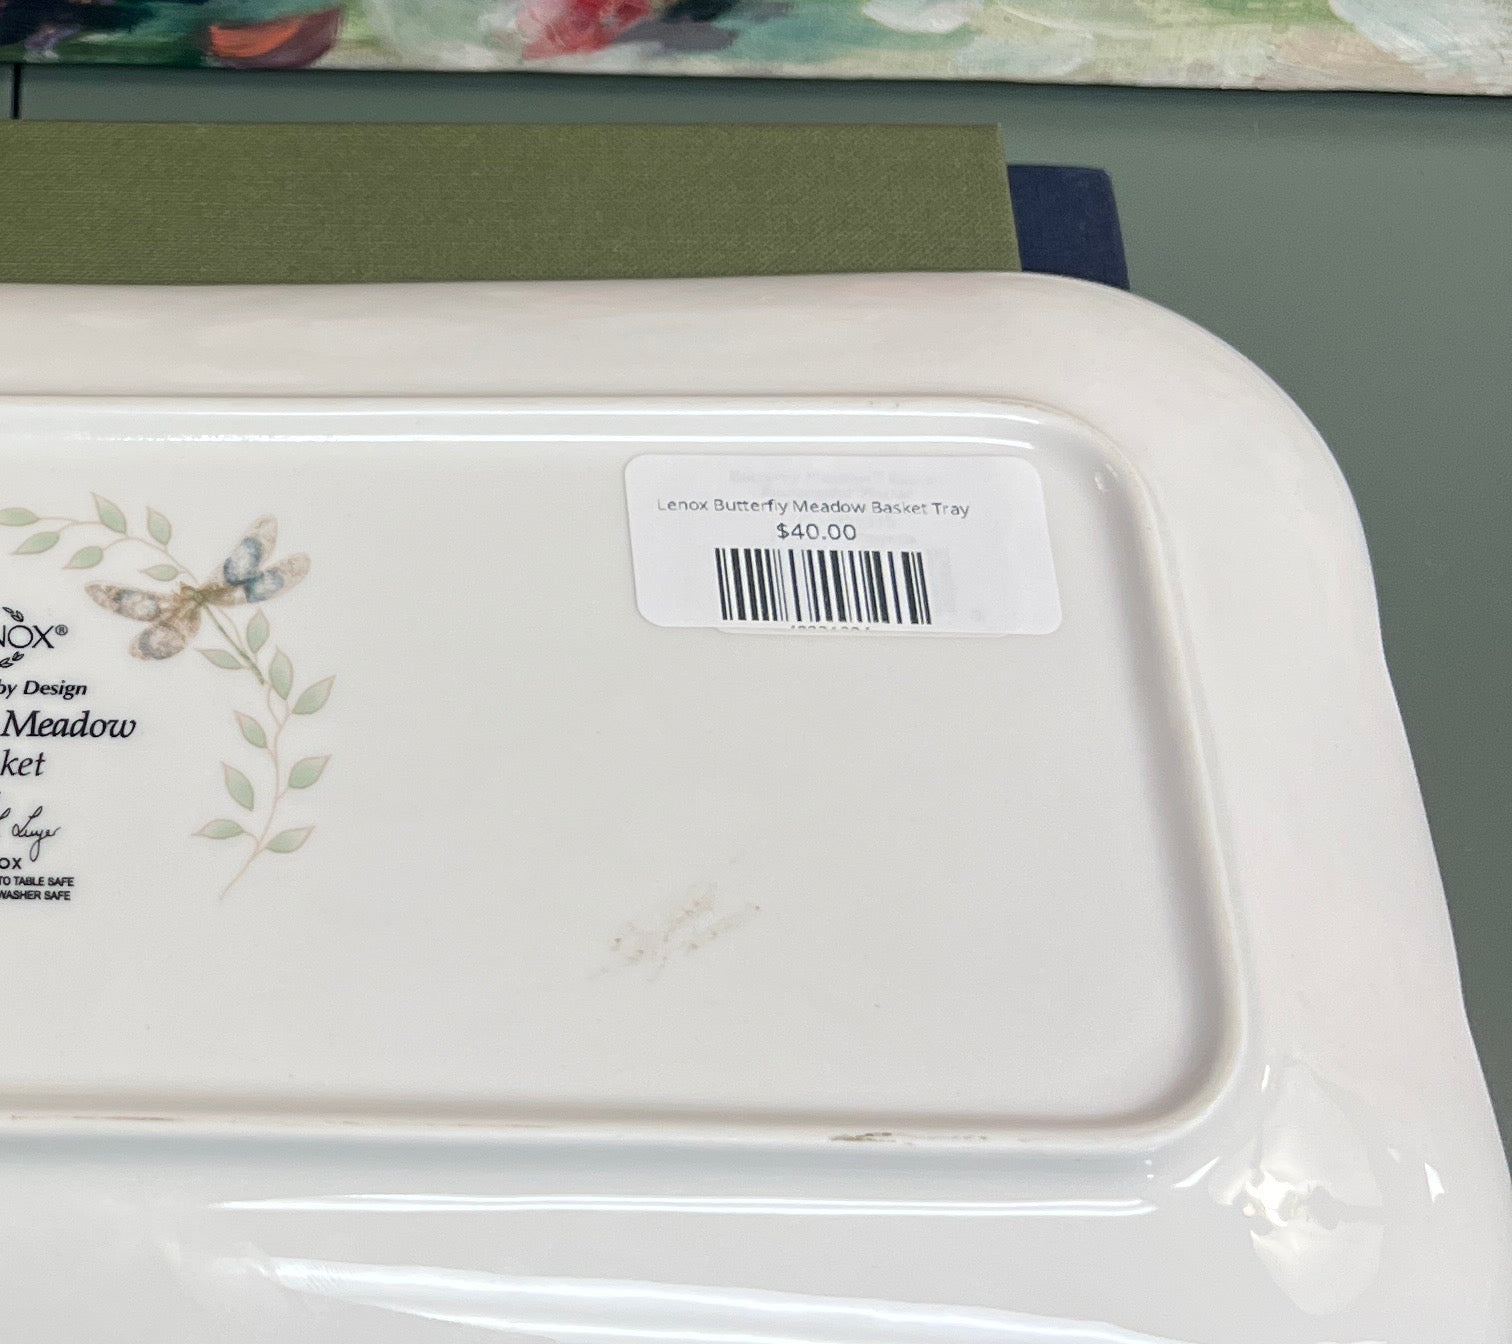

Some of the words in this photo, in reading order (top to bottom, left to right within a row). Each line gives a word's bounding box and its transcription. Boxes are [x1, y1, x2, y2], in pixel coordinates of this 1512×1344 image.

[656, 498, 708, 512] Lenox
[792, 499, 866, 515] Meadow
[872, 501, 927, 516] Basket
[931, 502, 971, 519] Tray
[776, 522, 857, 542] $40.00
[23, 680, 88, 700] Design
[0, 709, 137, 739] Meadow
[14, 875, 45, 887] TABLE
[47, 876, 76, 887] SAFE
[43, 890, 72, 901] SAFE
